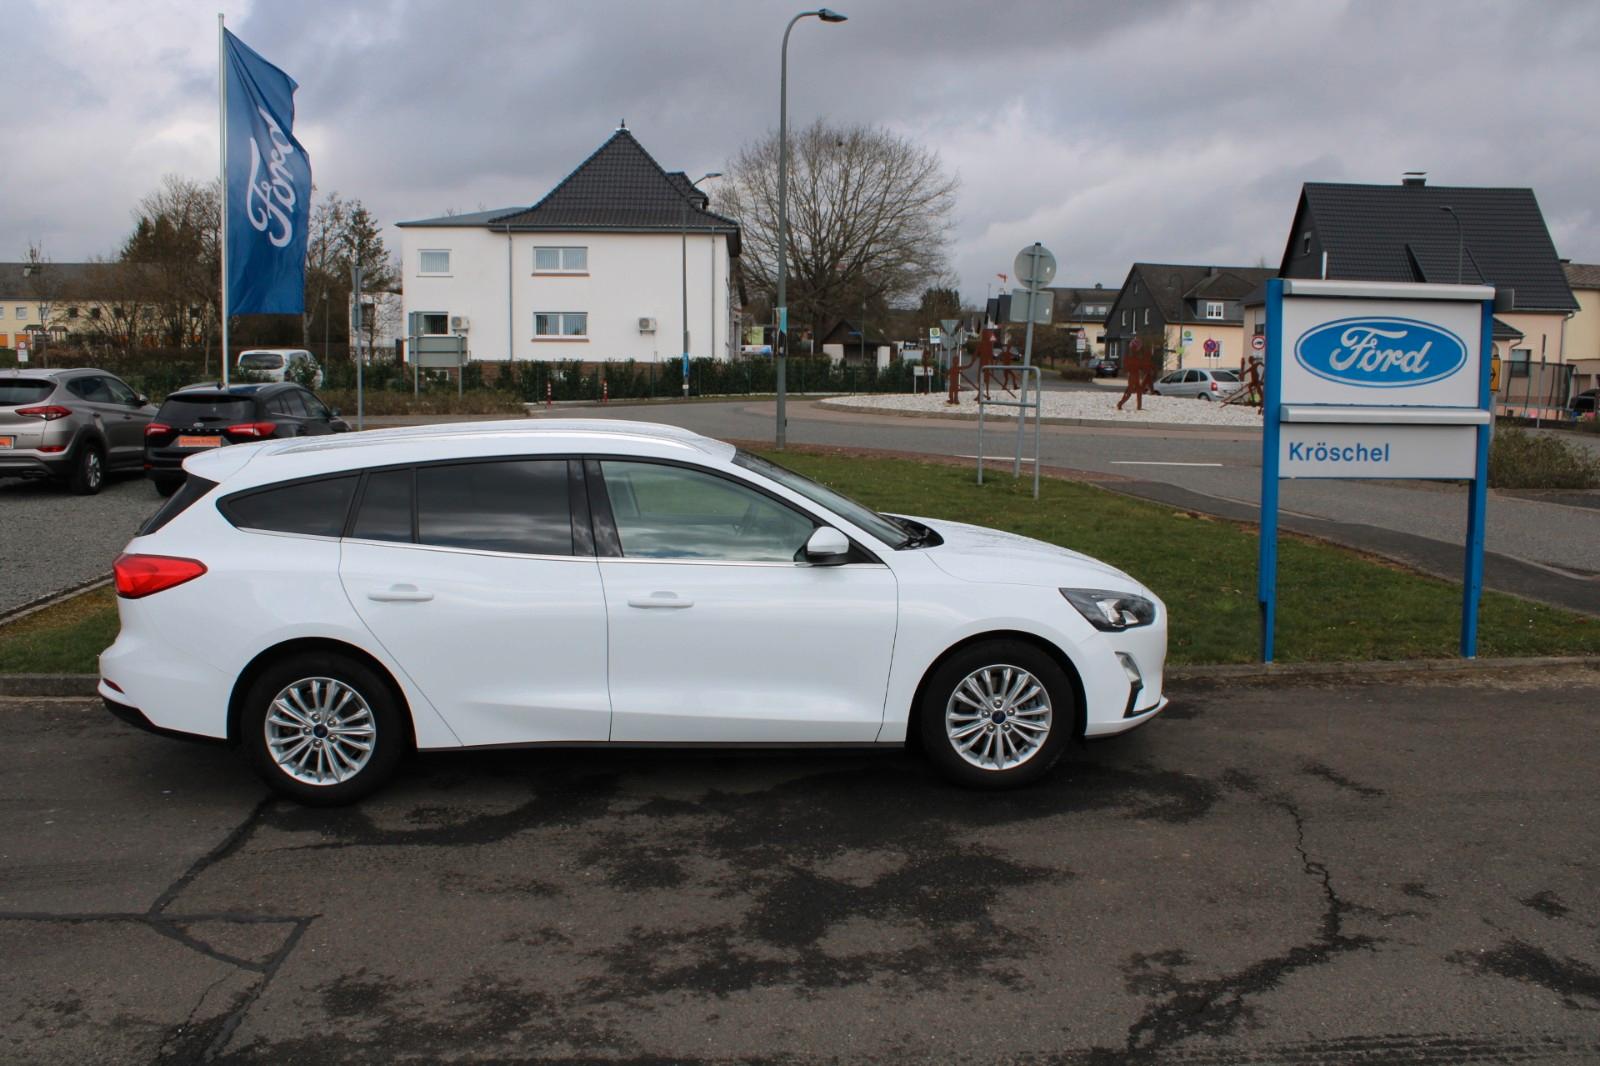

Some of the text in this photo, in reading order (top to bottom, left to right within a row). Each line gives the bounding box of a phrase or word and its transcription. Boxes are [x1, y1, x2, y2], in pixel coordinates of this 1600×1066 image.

[246, 105, 297, 248] Ford
[1329, 326, 1432, 373] Ford
[1289, 442, 1390, 462] Kröschel
